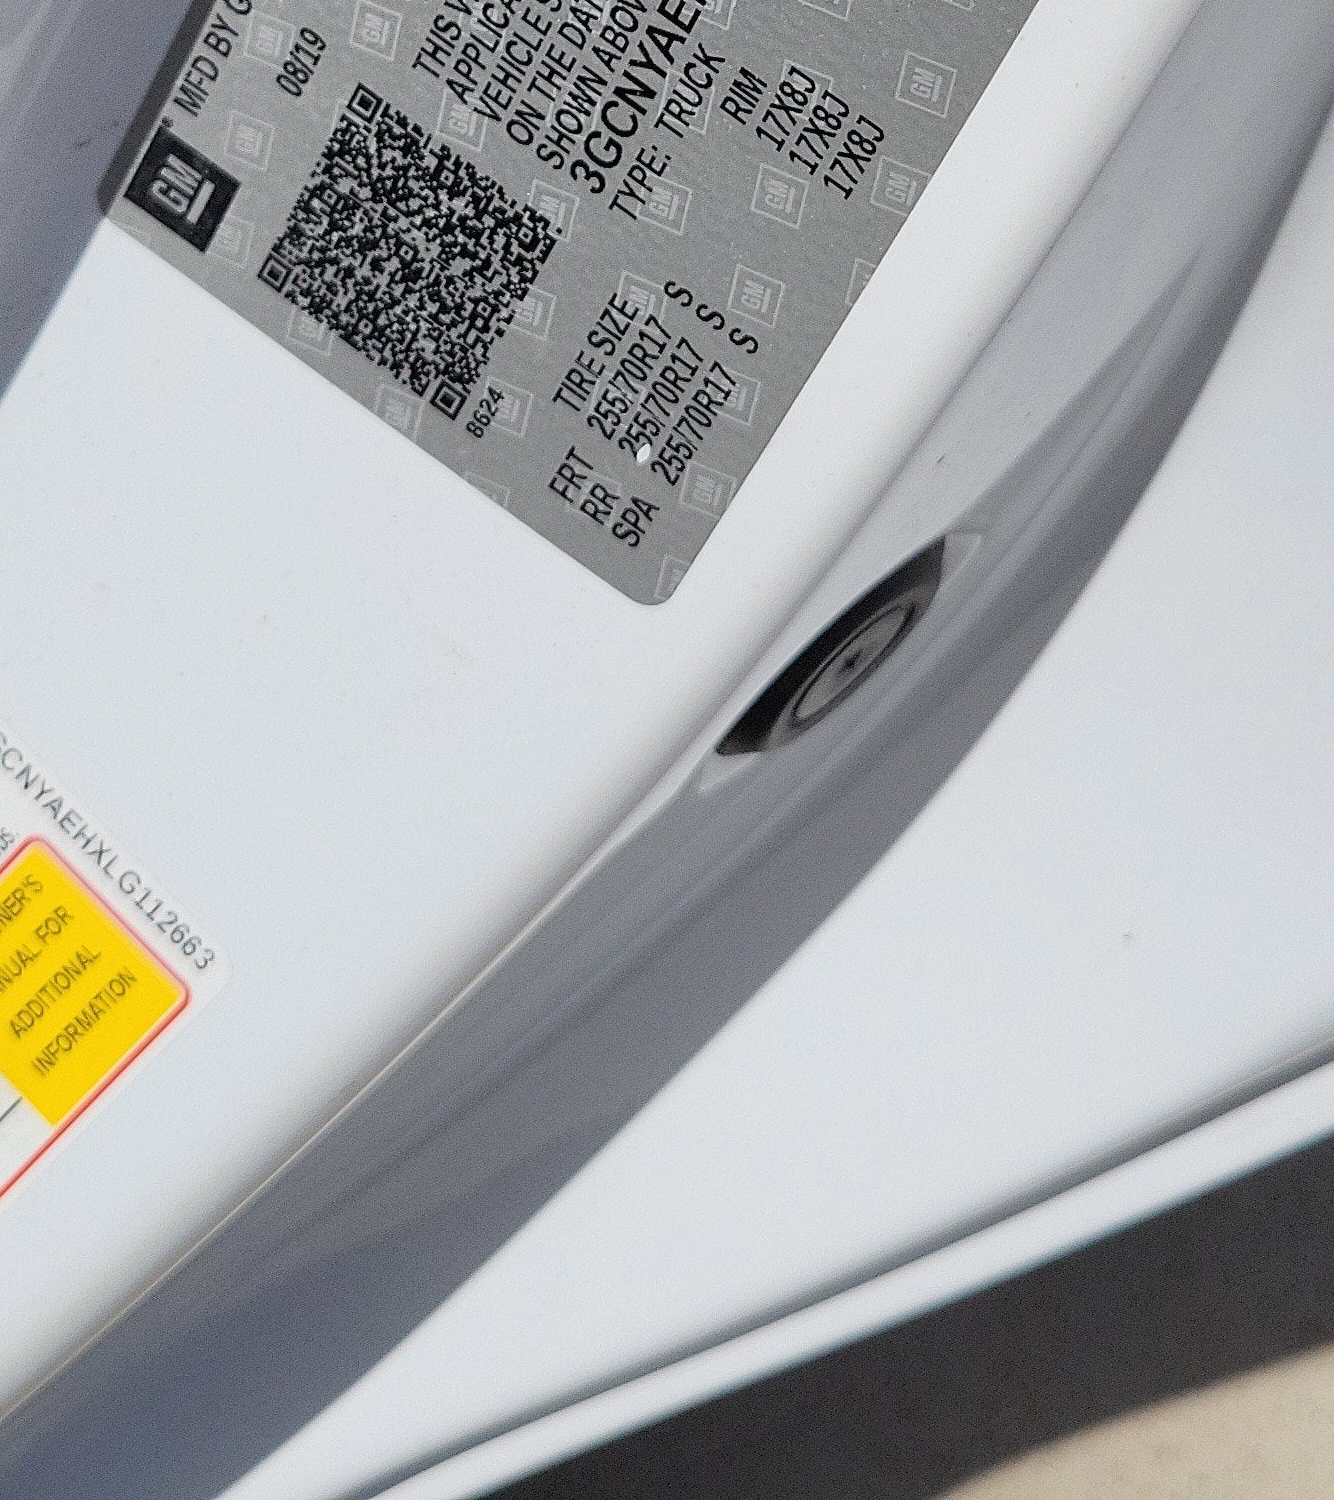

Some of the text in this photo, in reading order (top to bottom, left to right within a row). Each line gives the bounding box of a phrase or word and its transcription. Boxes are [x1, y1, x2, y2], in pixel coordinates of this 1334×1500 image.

[172, 55, 219, 117] MFD
[203, 13, 239, 58] BY
[275, 27, 327, 97] 08/19
[410, 14, 462, 79] THIS
[472, 6, 553, 123] VEHICLE
[505, 99, 546, 146] ON
[526, 43, 577, 102] THE
[535, 64, 608, 170] SHOWN
[608, 41, 726, 221] TYPE: TRUCK
[719, 66, 768, 126] RIM
[755, 65, 816, 152] 17X8J
[788, 89, 850, 176] 17X8J
[153, 155, 200, 214] GM
[823, 114, 885, 200] 17X8J
[547, 280, 694, 504] FRT 255/70R17 S
[551, 292, 640, 412] TIRE SIZE
[465, 386, 504, 439] 8624
[579, 303, 726, 526] RR 255/70R17 S
[611, 327, 759, 548] SPA 255/70R17 S
[33, 906, 71, 944] FOR
[9, 951, 101, 1039] ADDITIONAL
[32, 972, 137, 1076] INFORMATION
